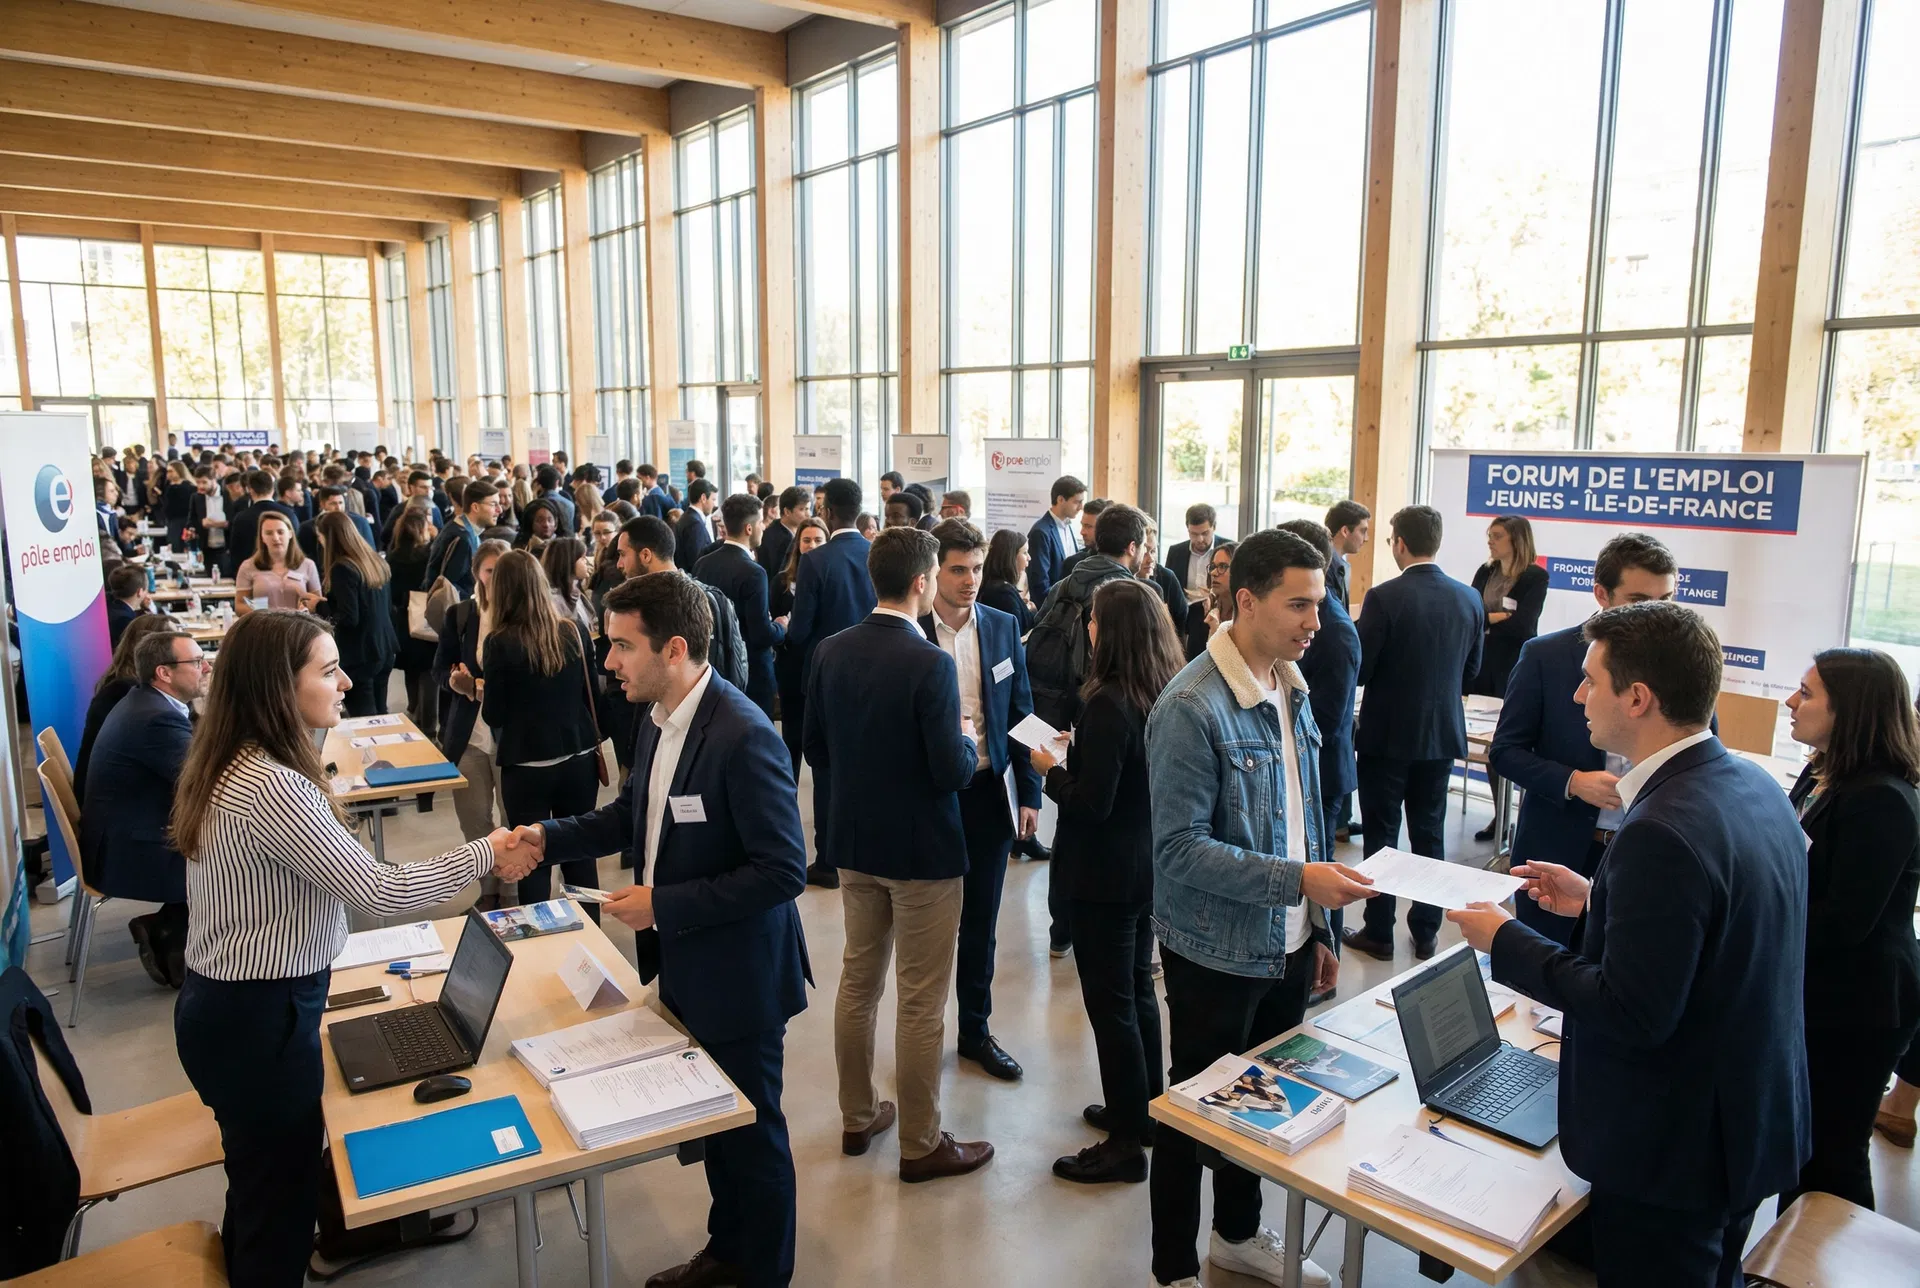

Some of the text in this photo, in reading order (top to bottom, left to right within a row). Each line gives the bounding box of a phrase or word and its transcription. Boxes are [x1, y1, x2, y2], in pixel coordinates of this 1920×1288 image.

[1487, 464, 1775, 495] FORUM DE L'EMPLOI
[1485, 489, 1564, 510] JEUNES
[1584, 488, 1773, 520] ÎLE-DE-FRANCE
[21, 537, 95, 574] pôle emploi
